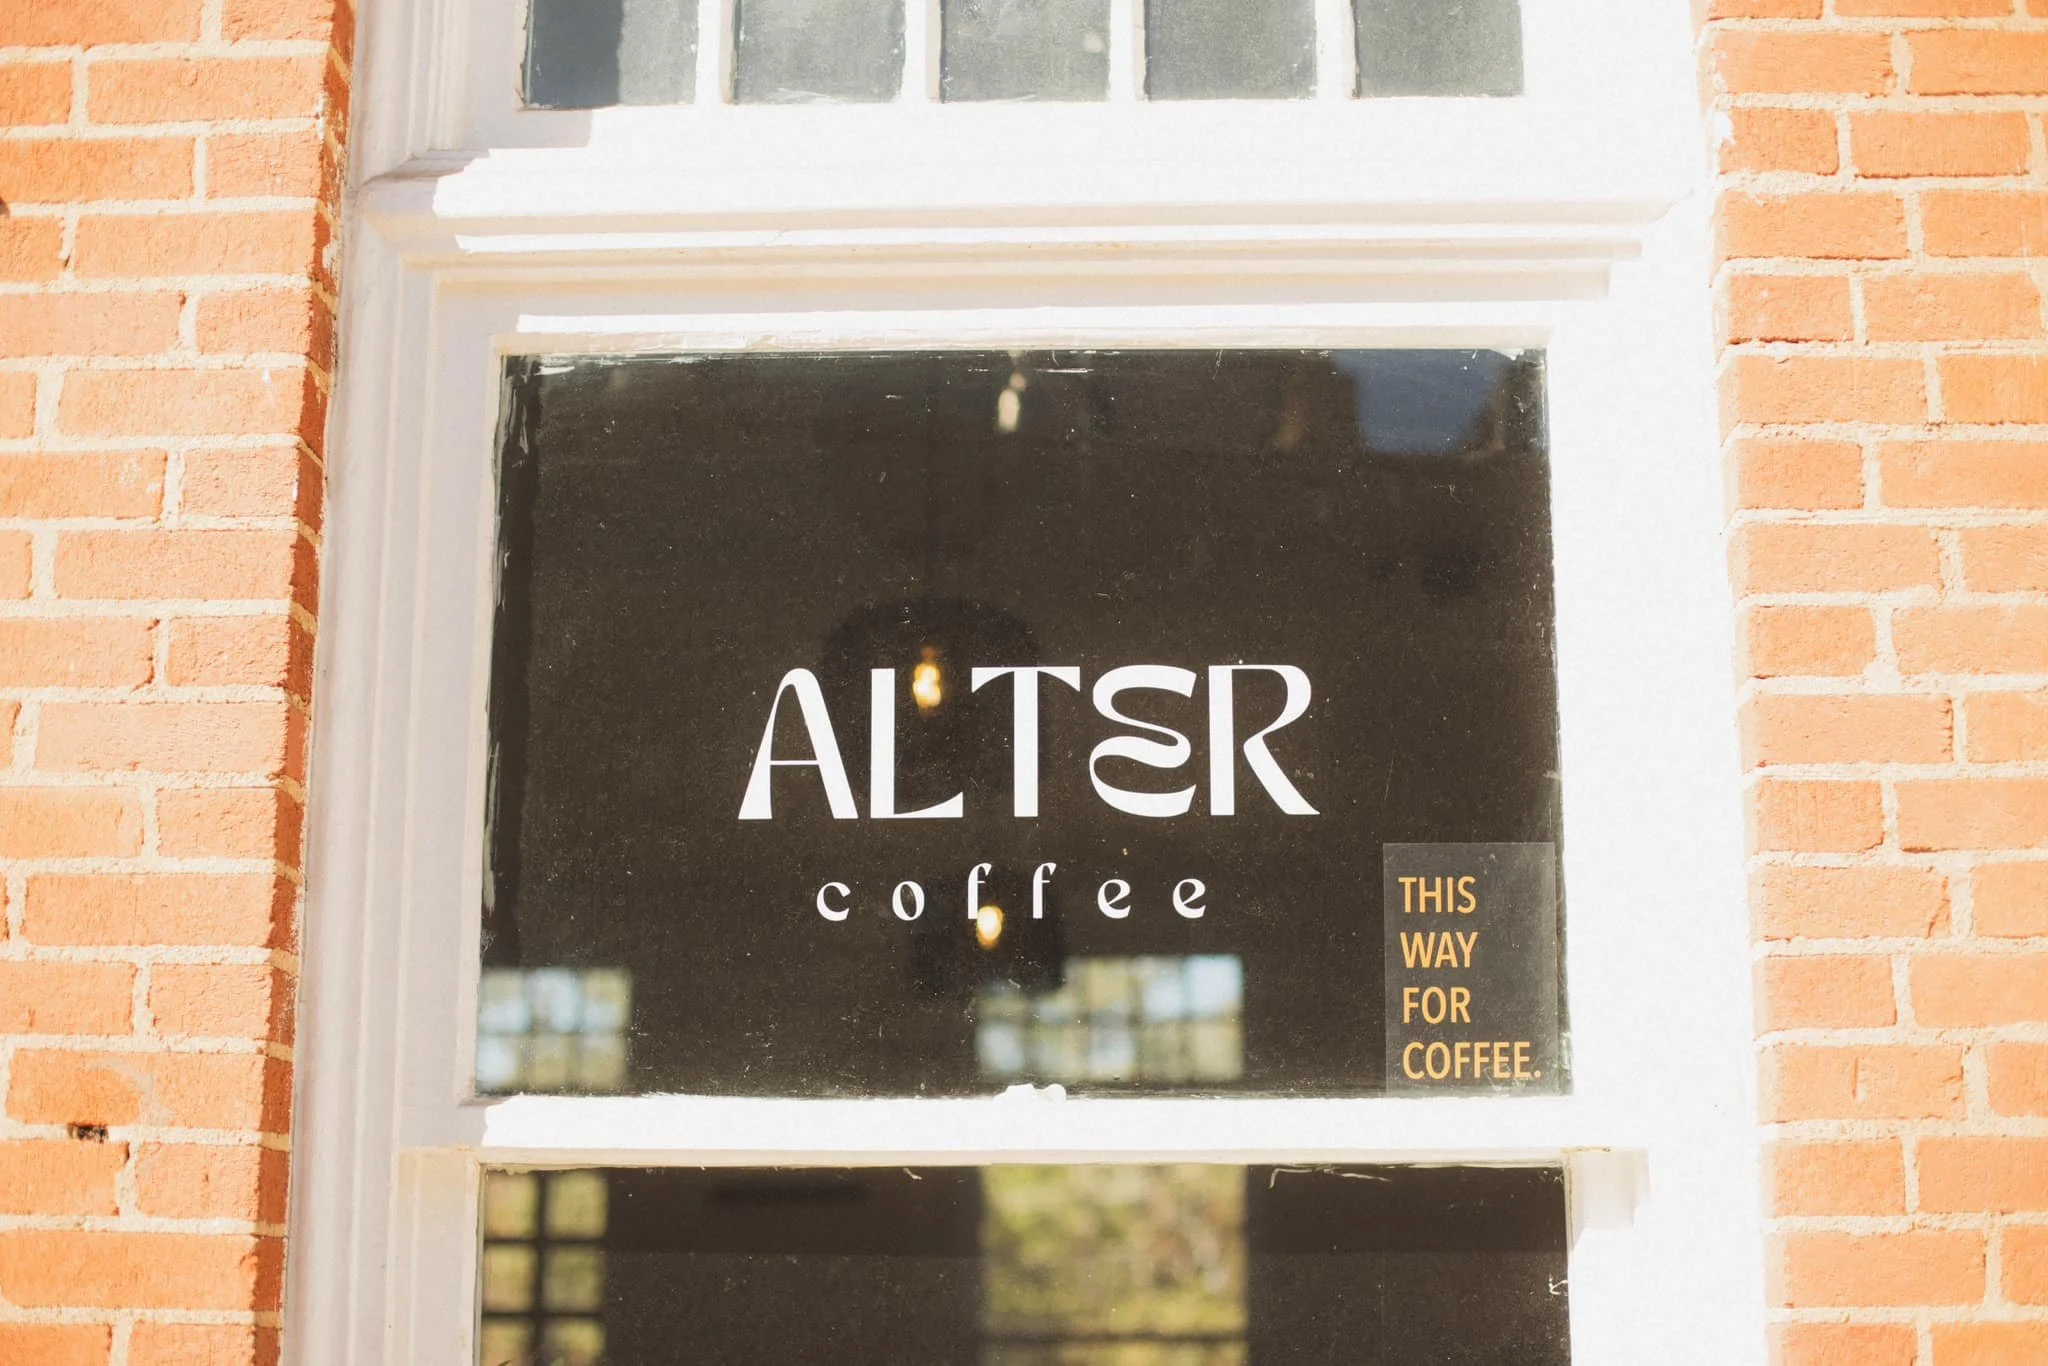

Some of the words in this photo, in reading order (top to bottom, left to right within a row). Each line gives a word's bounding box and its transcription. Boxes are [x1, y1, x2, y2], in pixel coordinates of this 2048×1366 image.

[738, 665, 1320, 819] ALTER
[816, 862, 1206, 921] coffee
[1398, 876, 1477, 914] THIS
[1400, 931, 1479, 969] WAY
[1402, 986, 1472, 1025] FOR
[1402, 1041, 1542, 1080] COFFEE.
